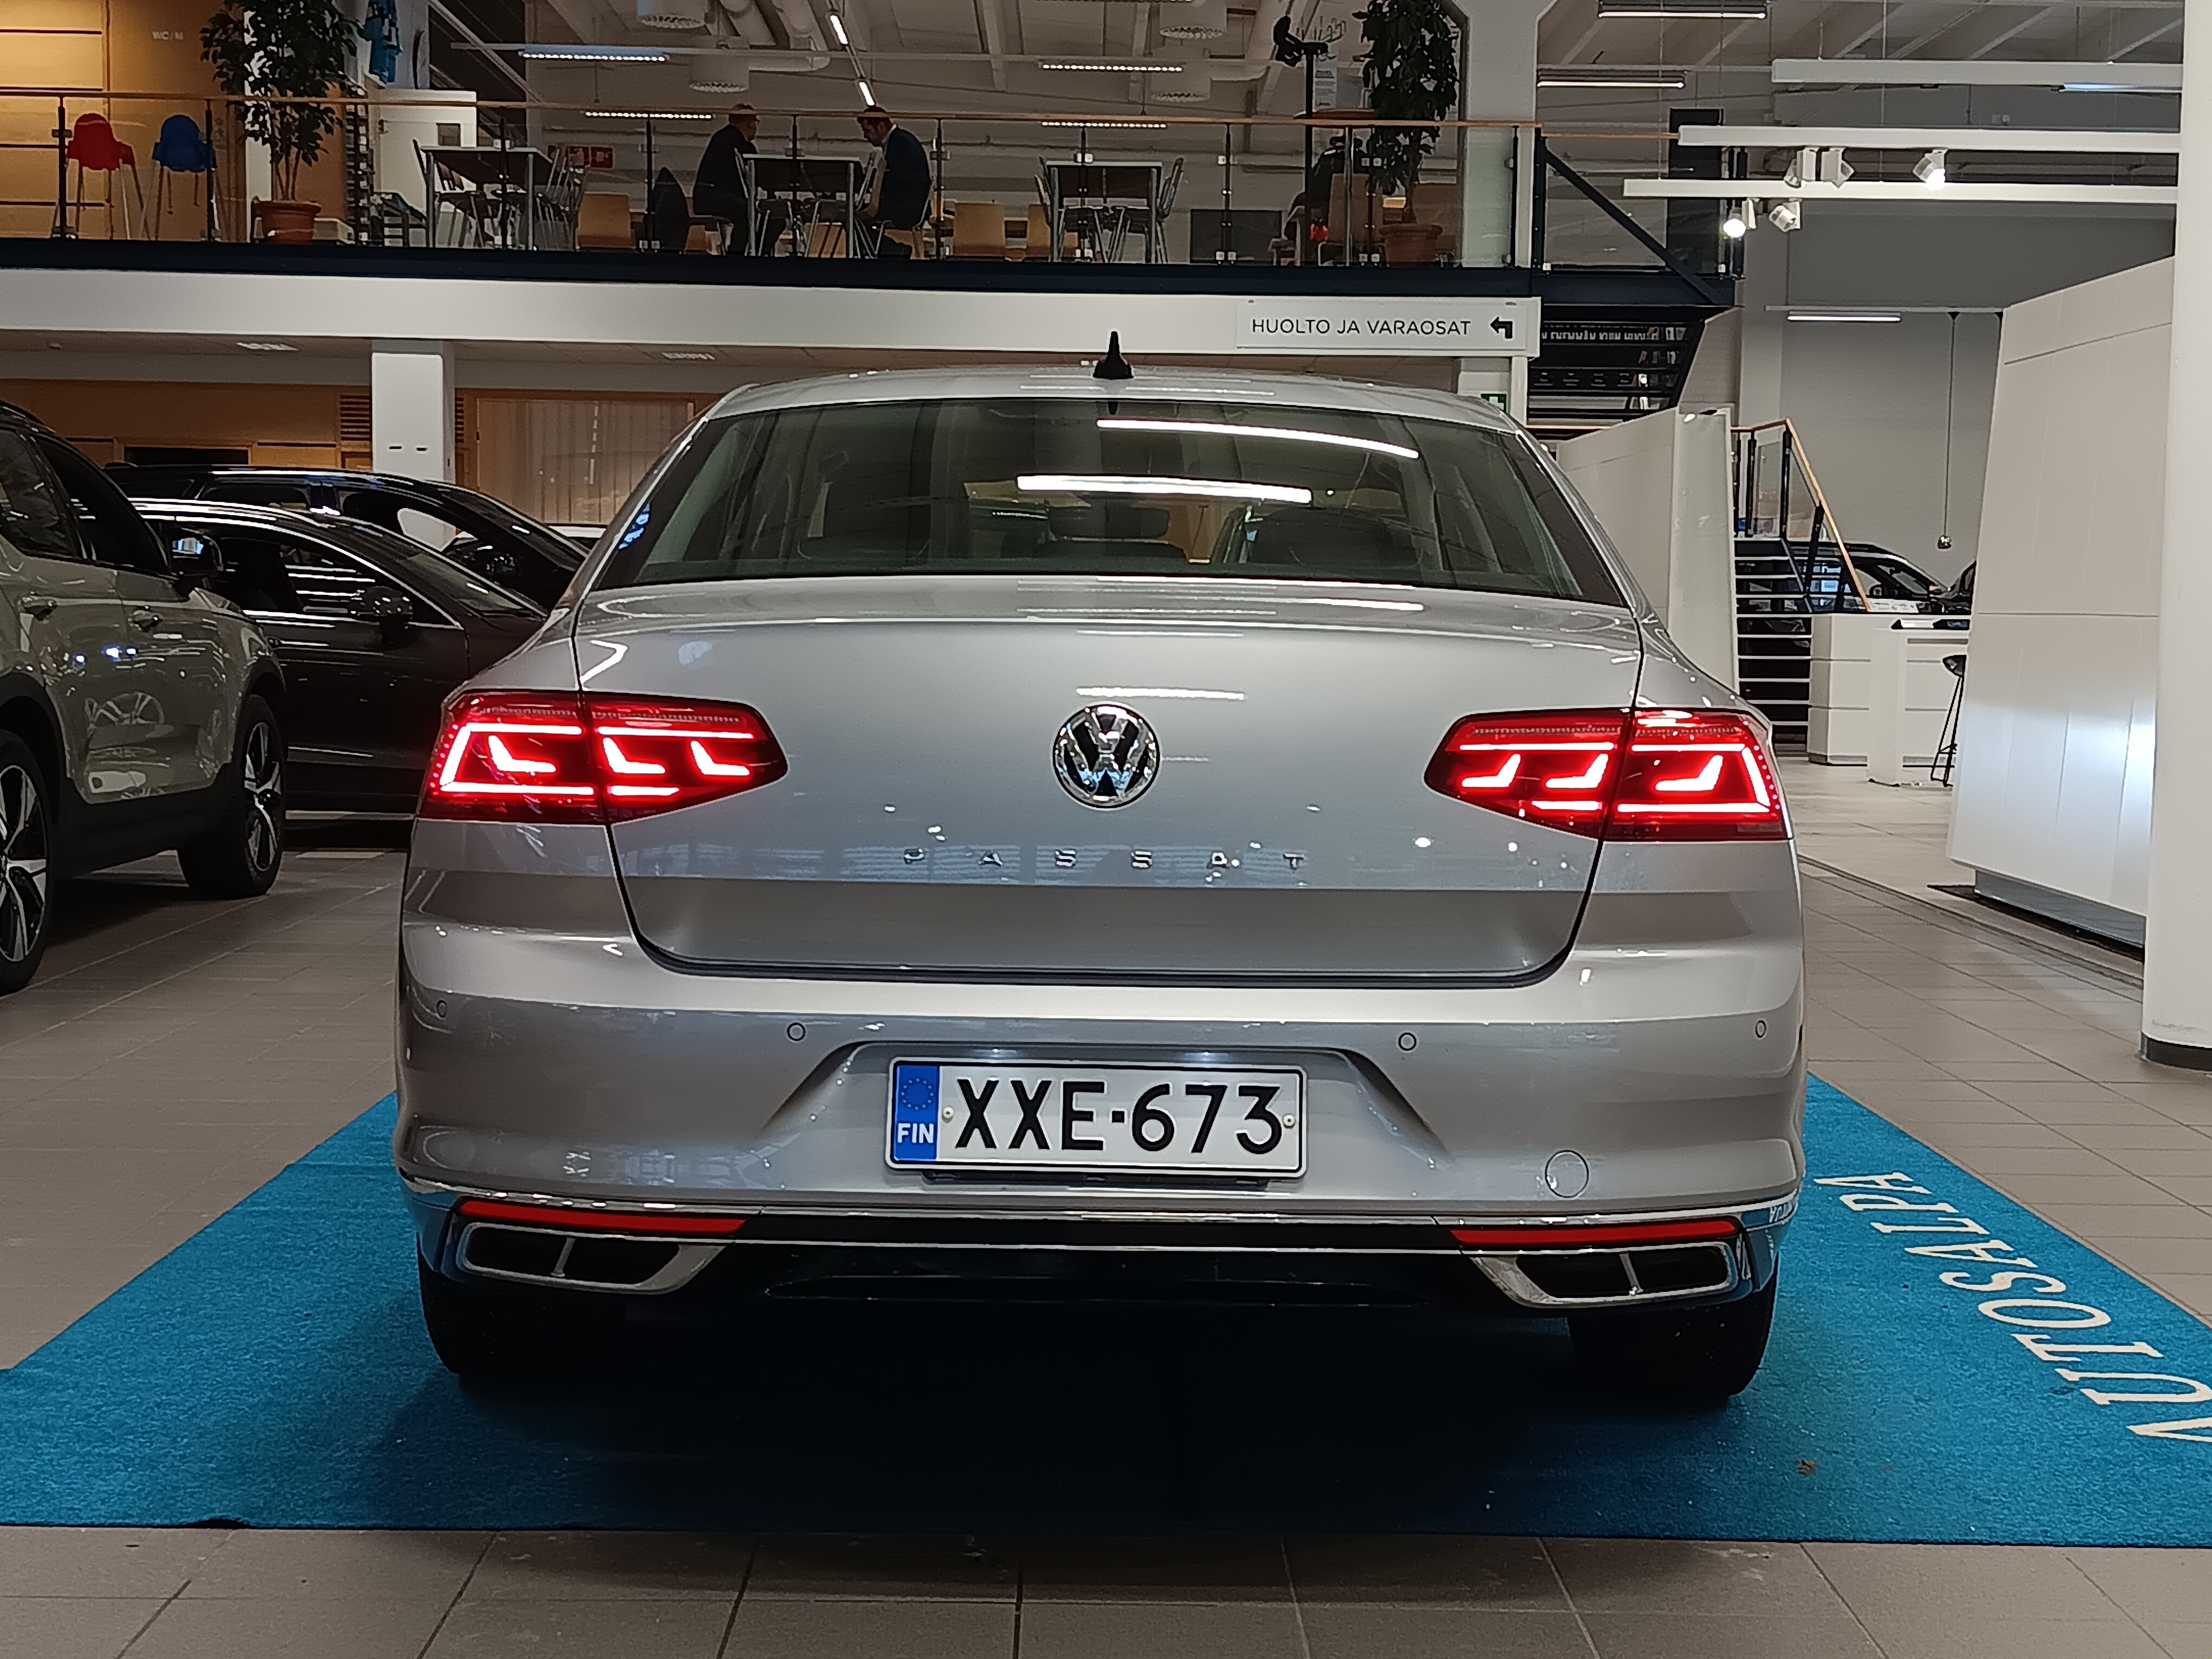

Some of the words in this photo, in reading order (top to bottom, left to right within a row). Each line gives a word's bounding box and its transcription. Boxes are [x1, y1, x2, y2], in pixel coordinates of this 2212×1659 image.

[1252, 319, 1330, 334] HUOLTO
[1337, 319, 1360, 335] JA
[1367, 320, 1471, 335] VARAOSAT
[903, 848, 1305, 870] PASSAT
[955, 1079, 1282, 1155] XXE-673
[897, 1123, 934, 1143] FIN
